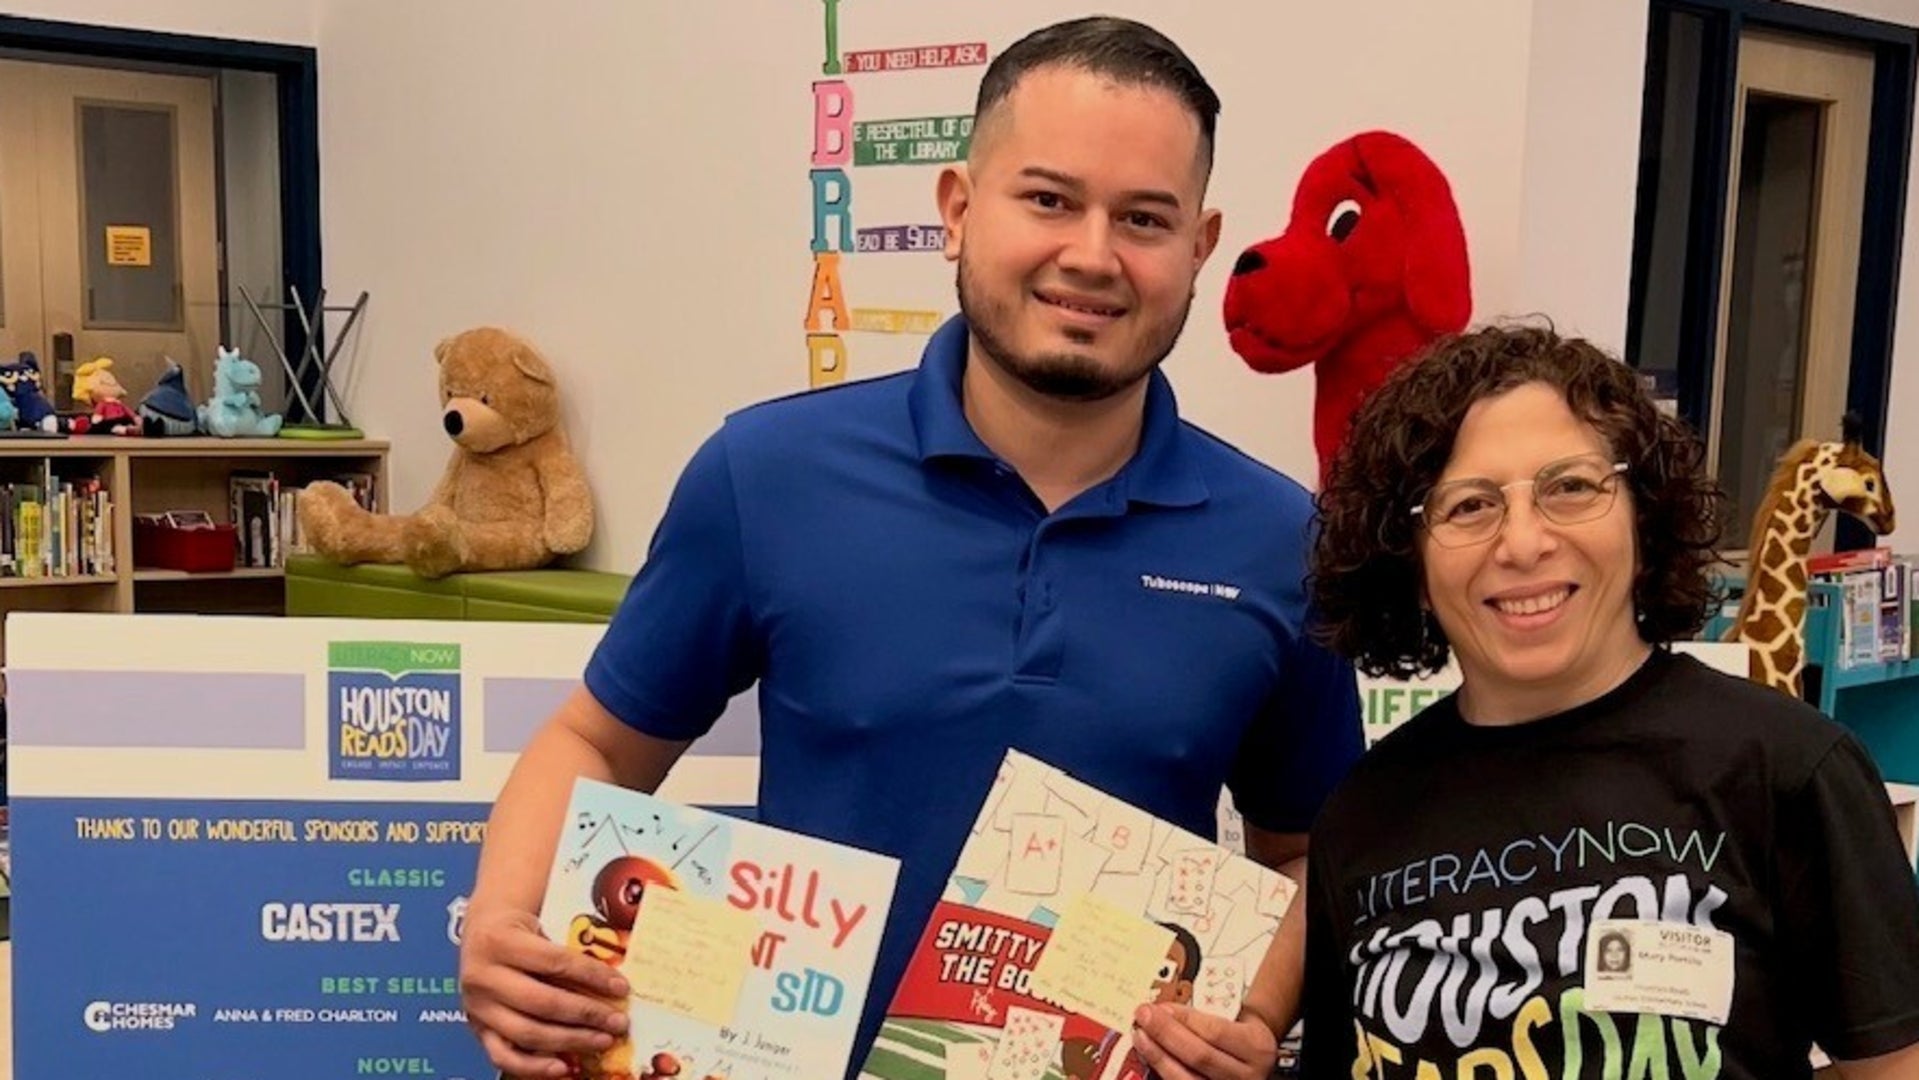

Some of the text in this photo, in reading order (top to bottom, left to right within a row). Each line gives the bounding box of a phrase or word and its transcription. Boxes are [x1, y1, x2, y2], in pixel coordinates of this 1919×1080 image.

[856, 53, 881, 70] YOU
[885, 50, 916, 69] NEED
[942, 119, 958, 137] OF
[873, 141, 961, 161] THE LIBRARY
[884, 233, 900, 250] BE
[341, 687, 449, 733] HOUSTON
[75, 818, 135, 840] THANKS
[142, 818, 161, 840] TO
[168, 818, 199, 840] OUR
[206, 819, 298, 841] WONDERFUL
[304, 819, 379, 842] SPONSORS
[386, 821, 420, 842] AND
[1112, 825, 1131, 850] B
[1224, 829, 1240, 842] to
[1022, 832, 1057, 861] A+
[348, 868, 446, 887] CLASSIC
[727, 860, 868, 949] Silly
[261, 903, 400, 942] CASTEX
[935, 921, 1043, 964] SMITTY
[1660, 930, 1712, 946] VISITOR
[940, 953, 995, 985] THE
[321, 977, 379, 994] BEST
[770, 968, 845, 1016] SID
[112, 1003, 196, 1017] CHESMAR
[214, 1009, 398, 1022] ANNA & FRED CHARLTON
[112, 1017, 175, 1029] HOMES
[358, 1058, 434, 1074] NOVEL
